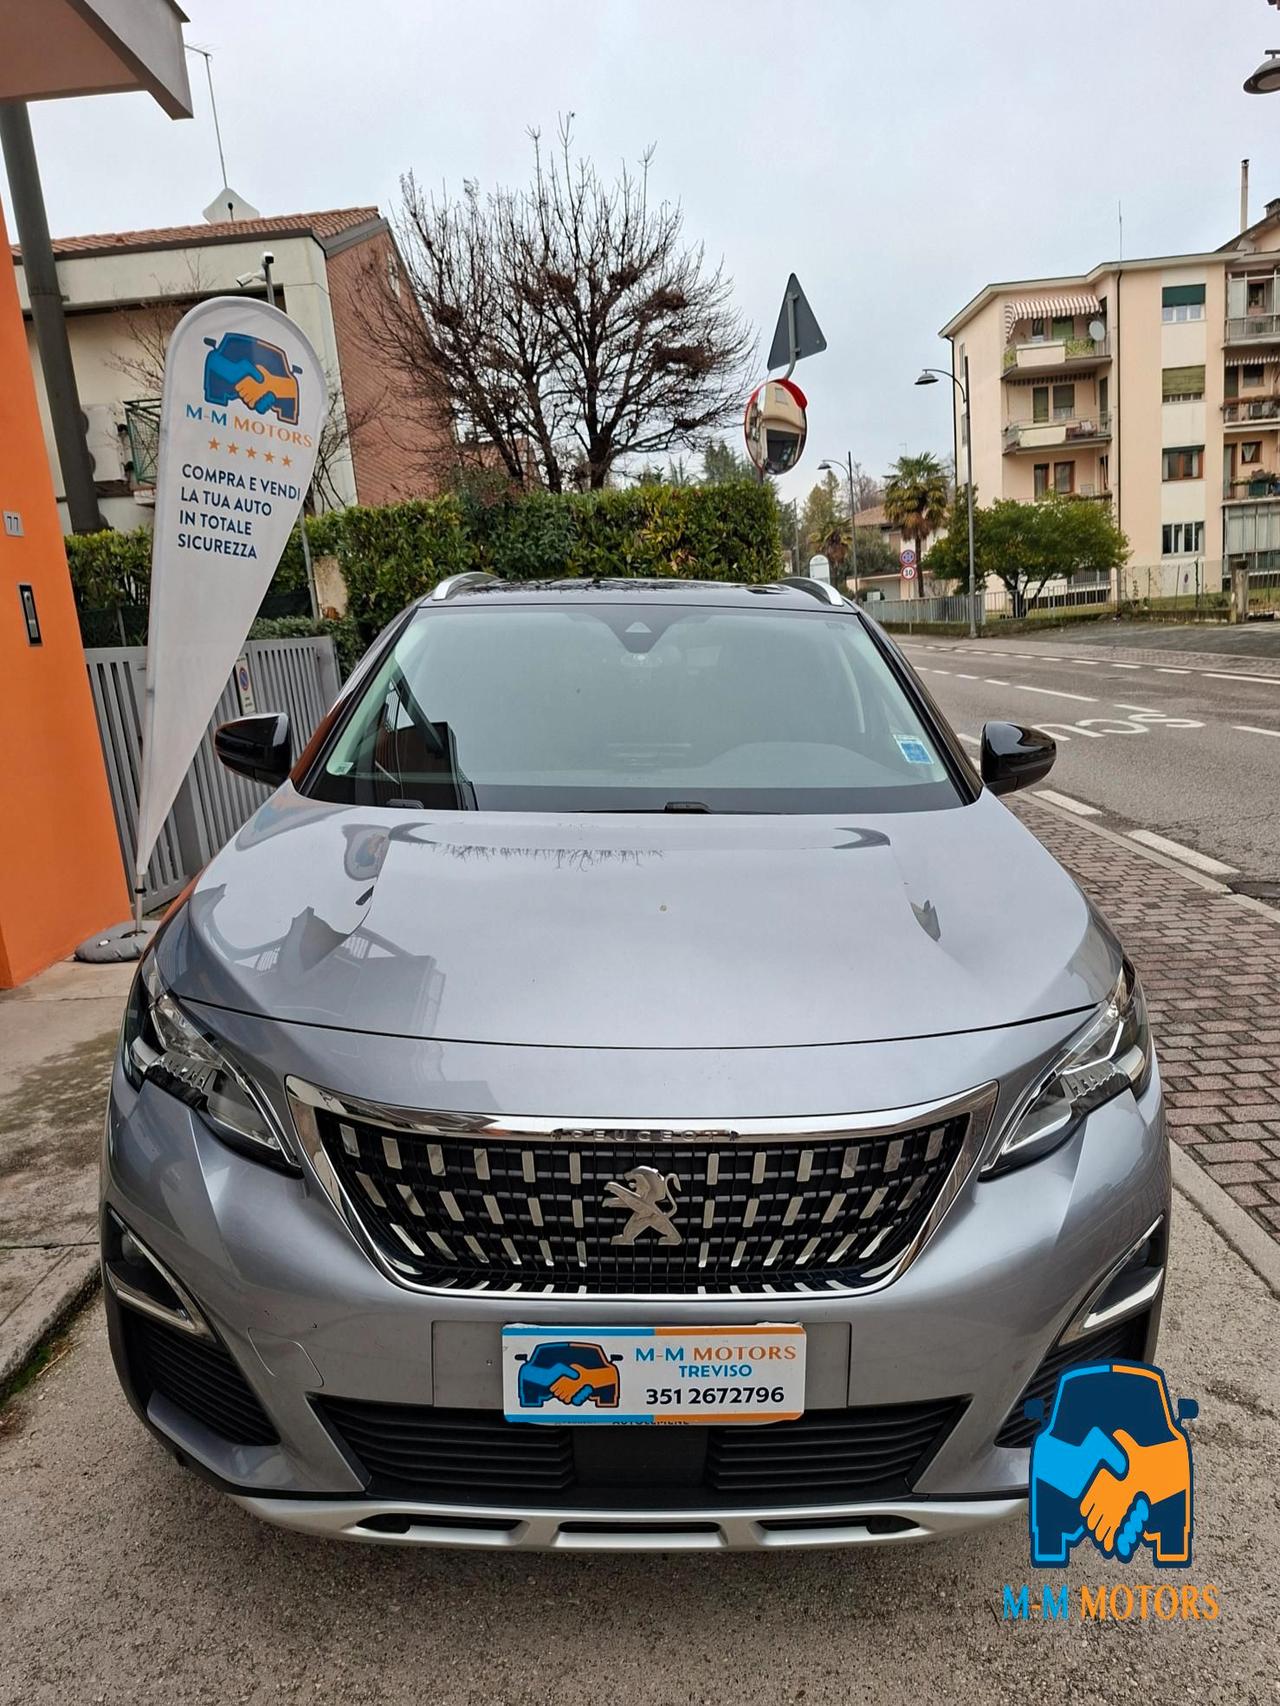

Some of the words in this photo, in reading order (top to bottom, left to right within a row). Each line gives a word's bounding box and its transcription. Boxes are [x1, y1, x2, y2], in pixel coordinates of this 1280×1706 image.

[186, 404, 227, 426] M-M
[234, 416, 313, 448] MOTORS
[182, 463, 246, 490] COMPRA
[249, 476, 258, 492] E
[260, 478, 301, 501] VENDI
[181, 486, 200, 504] LA
[203, 490, 231, 510] TUA
[233, 497, 272, 517] AUTO
[7, 516, 19, 531] 77
[179, 509, 196, 526] IN
[200, 513, 252, 536] TOTALE
[178, 533, 257, 559] SICUREZZA
[572, 1129, 719, 1142] PEUGEOT
[635, 1347, 684, 1362] M-M
[693, 1345, 797, 1361] MOTORS
[679, 1364, 753, 1378] TREVISO
[645, 1387, 682, 1405] 351
[688, 1386, 785, 1404] 2672796
